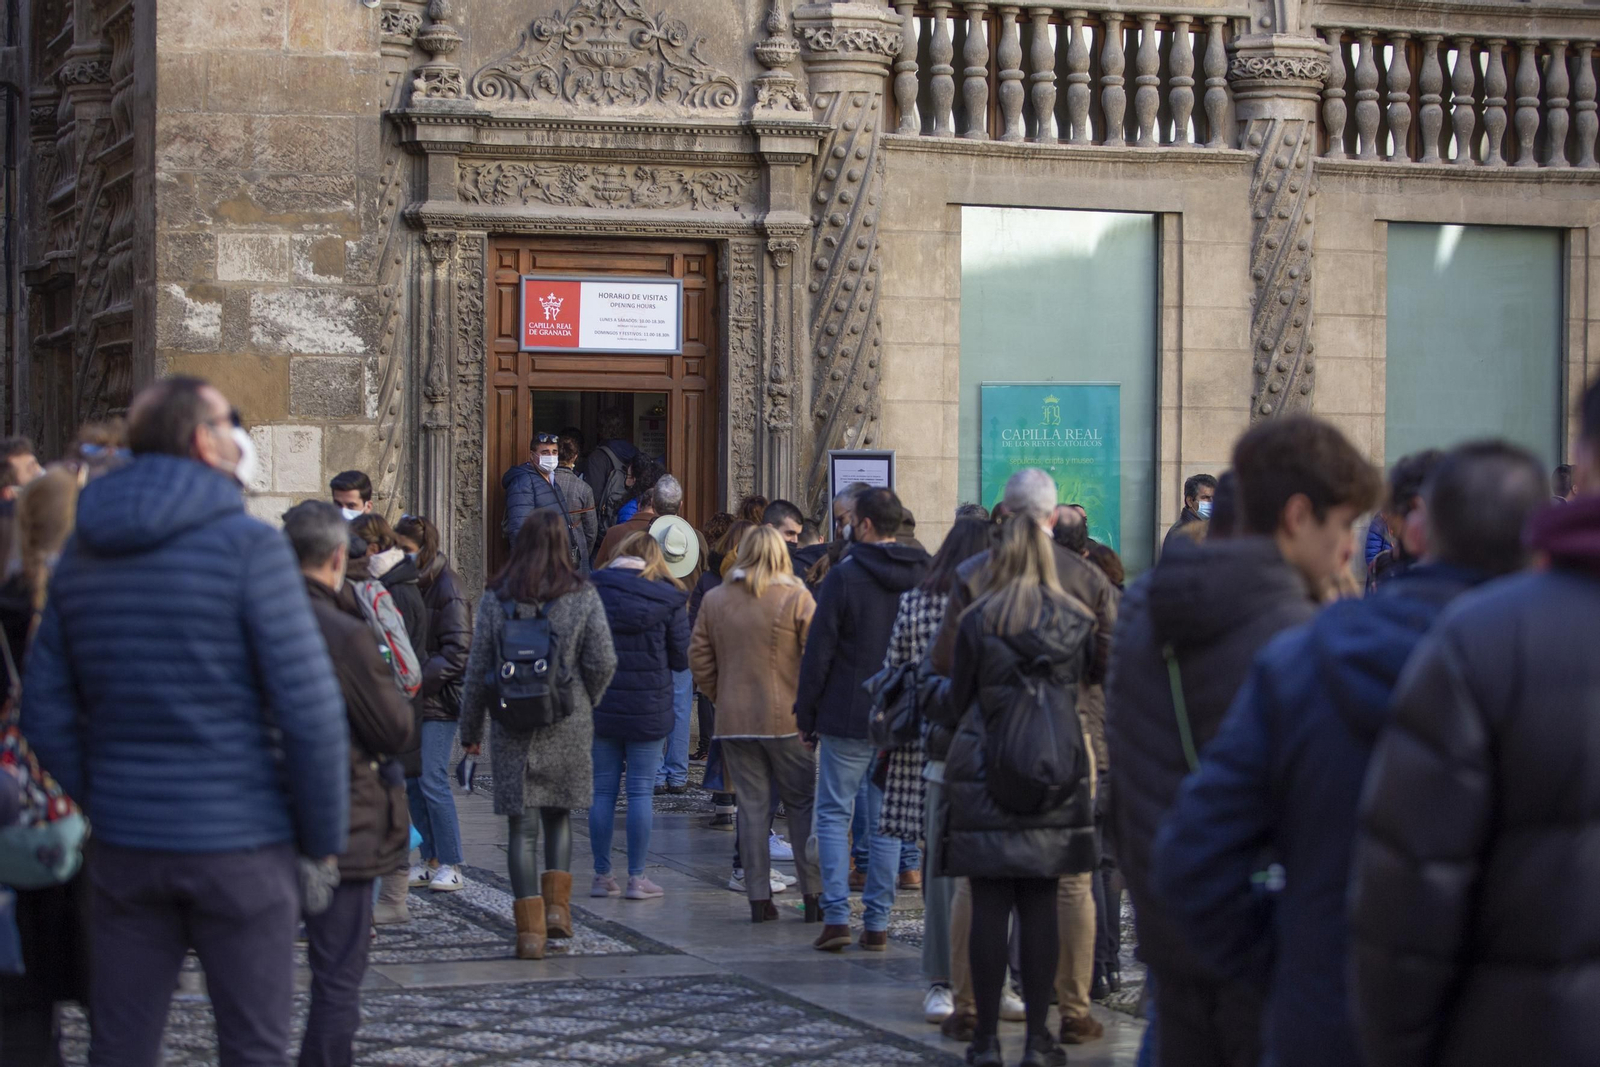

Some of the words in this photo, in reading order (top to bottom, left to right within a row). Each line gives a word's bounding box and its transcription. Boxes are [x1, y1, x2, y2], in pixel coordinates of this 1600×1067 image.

[598, 292, 630, 300] HORARIO
[1002, 428, 1060, 440] CAPILLA
[1065, 428, 1102, 440] REAL
